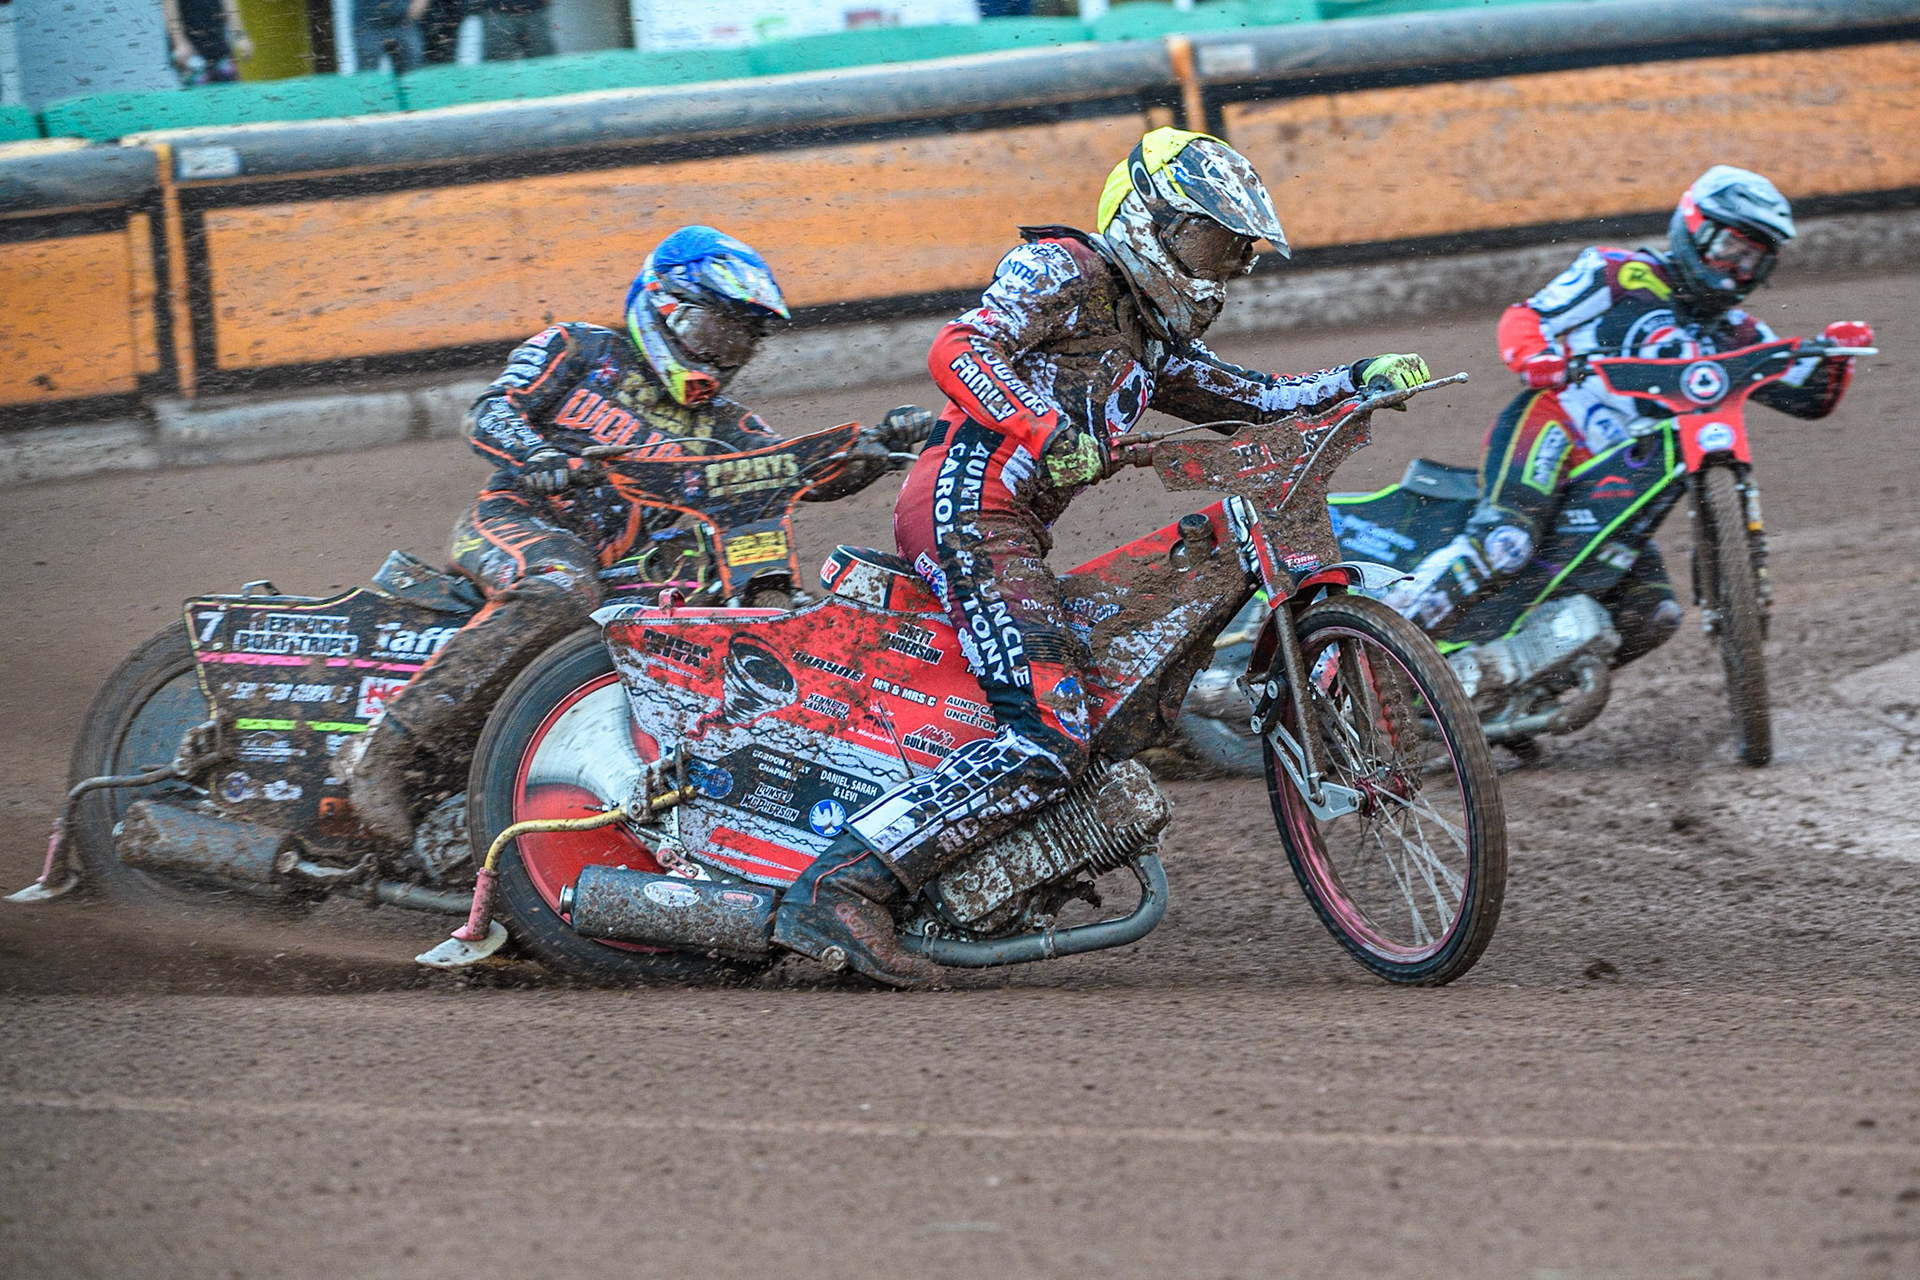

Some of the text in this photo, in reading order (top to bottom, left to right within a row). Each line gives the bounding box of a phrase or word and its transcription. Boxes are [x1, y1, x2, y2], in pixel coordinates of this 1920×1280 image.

[951, 352, 1017, 422] FAMILY
[935, 442, 966, 544] CAROL
[959, 441, 990, 540] AUNTY
[197, 611, 225, 642] 7
[962, 593, 1009, 684] TONY
[979, 577, 1031, 688] UNCLE
[880, 630, 944, 665] NDERSON
[808, 692, 850, 712] KENNETH
[871, 676, 937, 707] MR & MRS C
[945, 695, 979, 712] AUNTY
[800, 700, 849, 721] SAUNDERS
[945, 709, 998, 732] UNCLE TON
[903, 734, 955, 759] BULK WOO
[752, 749, 786, 767] GORDON
[793, 763, 811, 775] AT
[820, 769, 878, 797] DANIEL, SARAH
[833, 786, 858, 803] & LEVI
